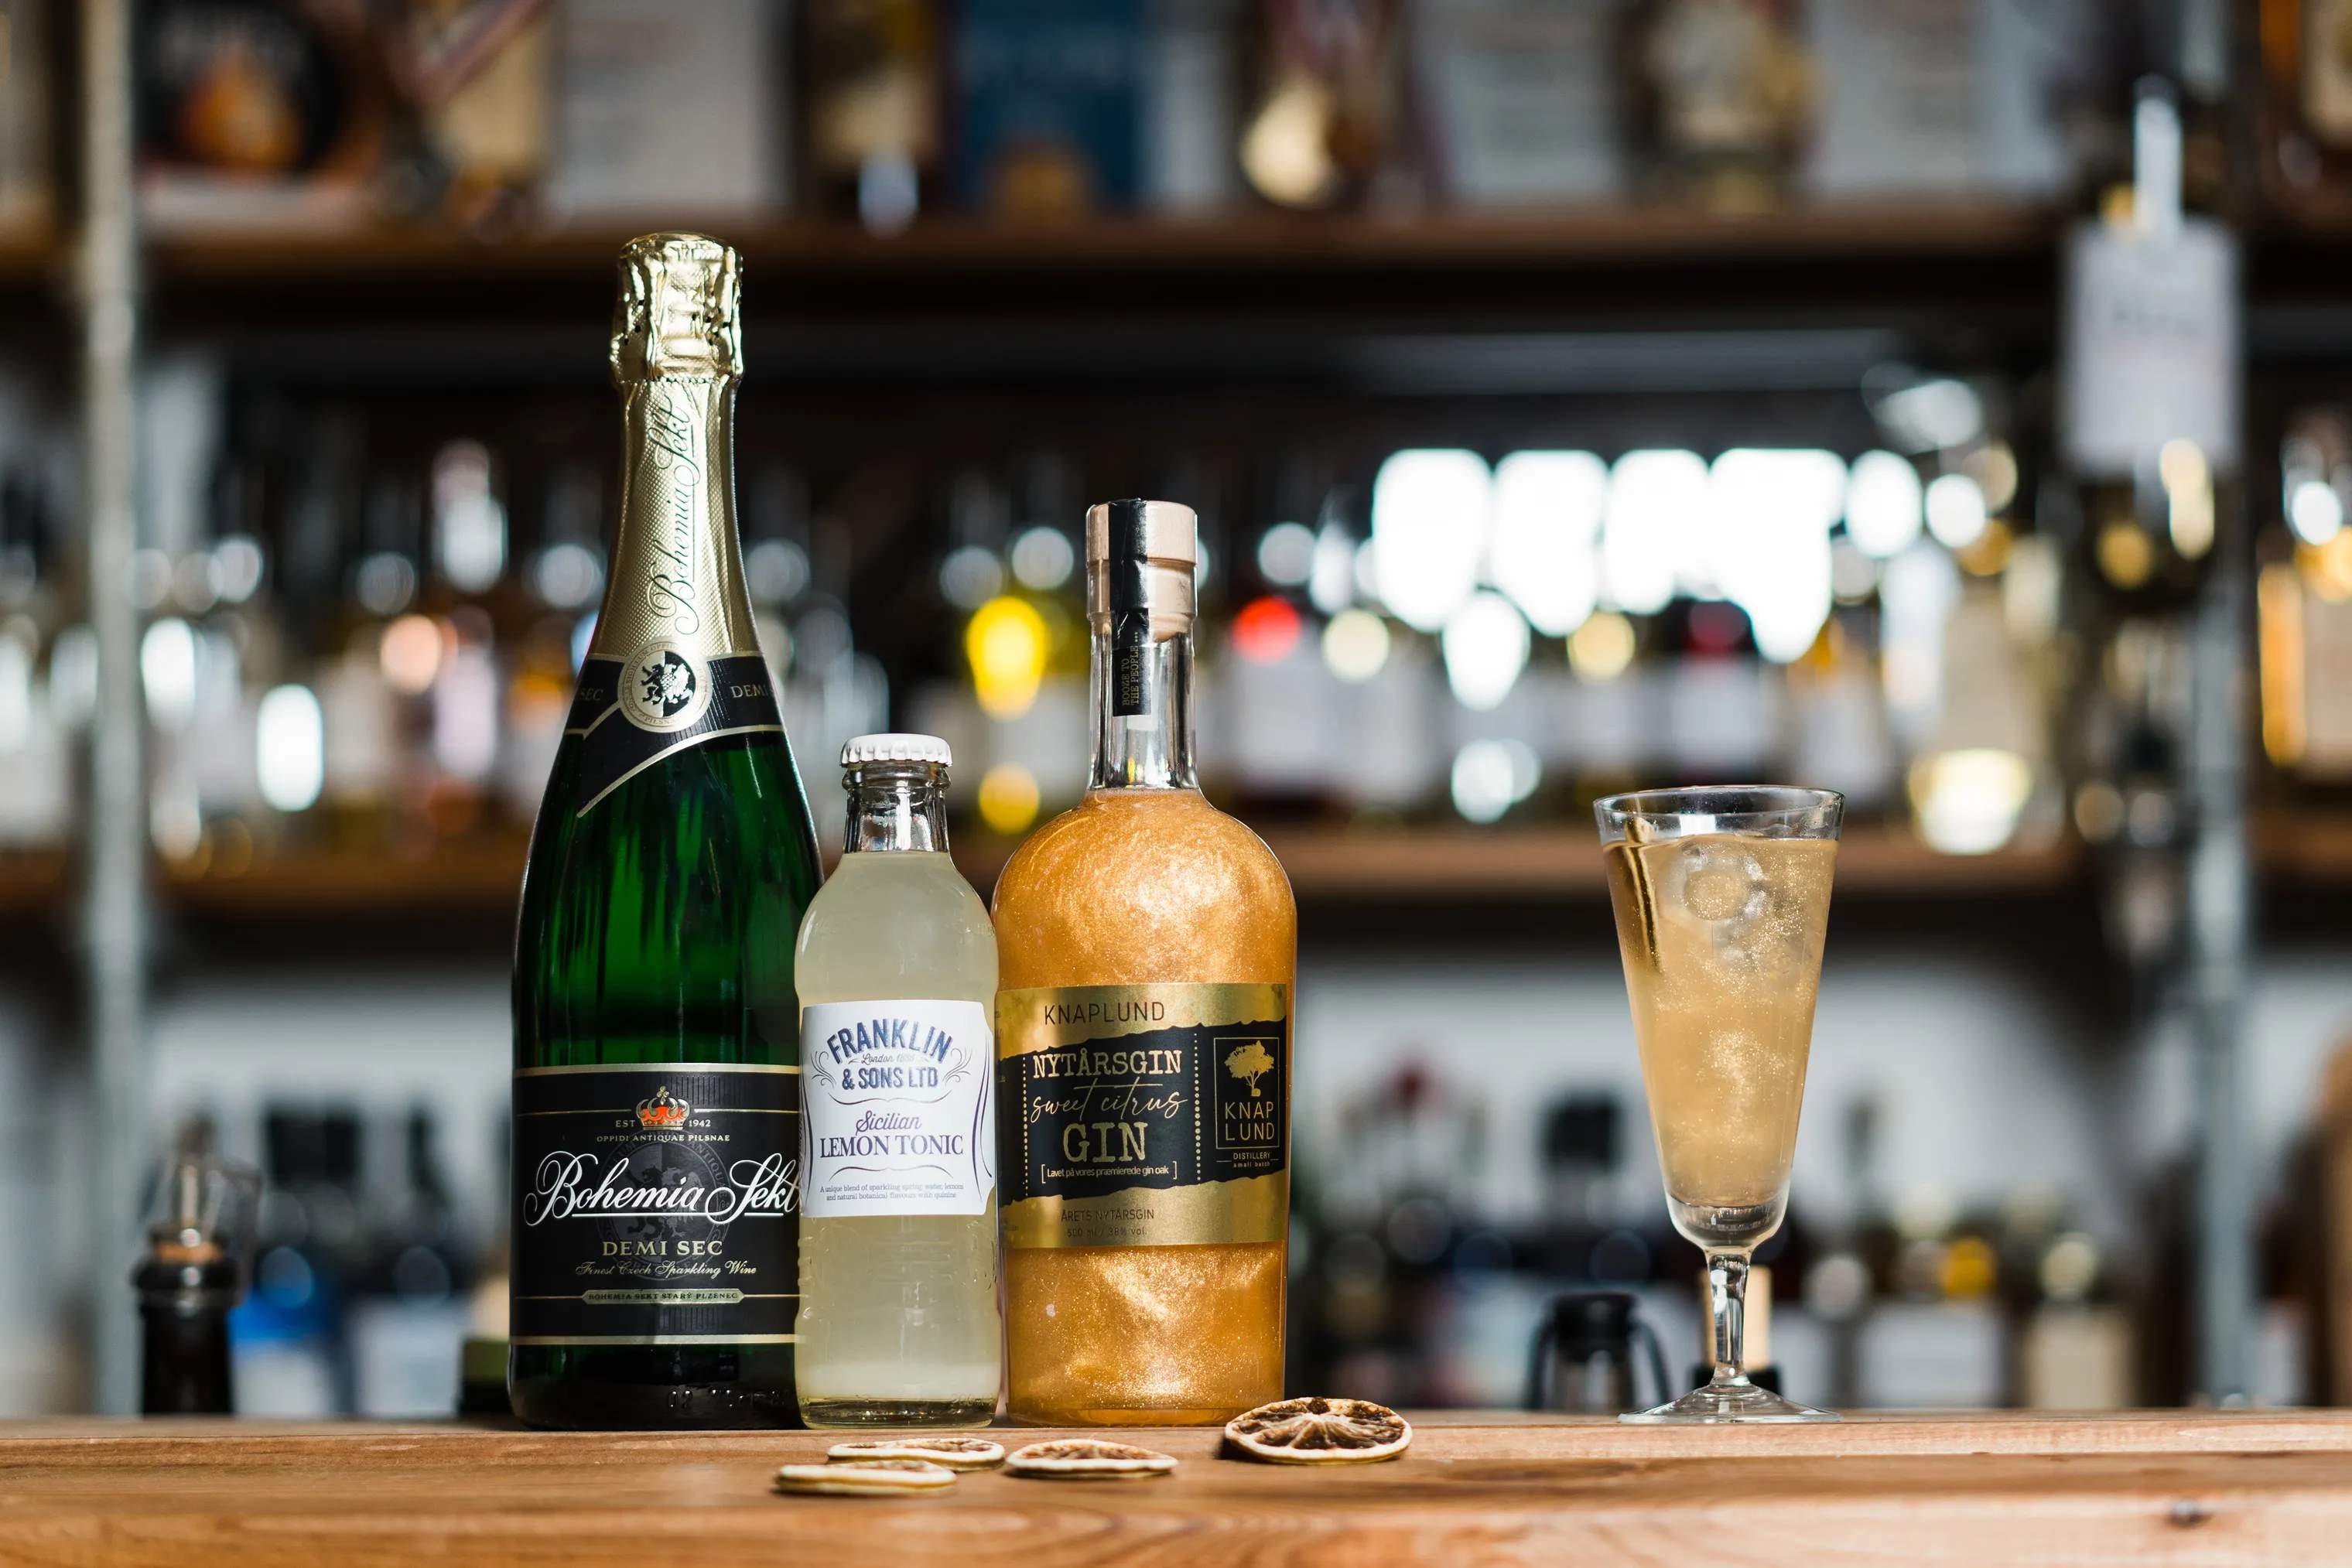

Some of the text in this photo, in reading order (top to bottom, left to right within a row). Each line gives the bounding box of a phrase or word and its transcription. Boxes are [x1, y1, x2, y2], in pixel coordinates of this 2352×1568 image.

[647, 395, 701, 635] Bohemia Sekt
[1130, 645, 1139, 682] PEOPLE
[1121, 658, 1130, 705] BOOZE TO
[1130, 685, 1139, 705] THE
[1044, 1001, 1165, 1026] KNAPLUND
[826, 1018, 953, 1065] FRANKLIN
[860, 1053, 894, 1066] London
[1032, 1047, 1182, 1079] NYTÅRSGIN
[842, 1066, 938, 1091] & SONS LTD
[1030, 1076, 1189, 1124] sweet citrus
[1225, 1101, 1274, 1120] KNAP
[615, 1119, 711, 1128] EST 1942
[855, 1110, 922, 1137] Sicilian
[1225, 1122, 1275, 1141] LUND
[597, 1133, 731, 1143] OPPIDI ANTIQUAE PILSNAE
[819, 1135, 890, 1159] LEMON
[894, 1134, 964, 1156] TONIC
[1063, 1121, 1149, 1163] GIN
[1232, 1151, 1270, 1160] DISTILLERY
[1047, 1165, 1169, 1179] Lavet på vores præmierede gin oak
[523, 1150, 800, 1228] Bohemia Sekt
[825, 1185, 843, 1194] unique
[869, 1183, 901, 1192] sparkling
[1130, 1226, 1147, 1236] vol.
[602, 1240, 723, 1256] DEMI SEC
[576, 1259, 757, 1279] Finest Czech Sparkling Wine
[634, 1292, 658, 1300] SEKT
[662, 1290, 692, 1300] STARÝ
